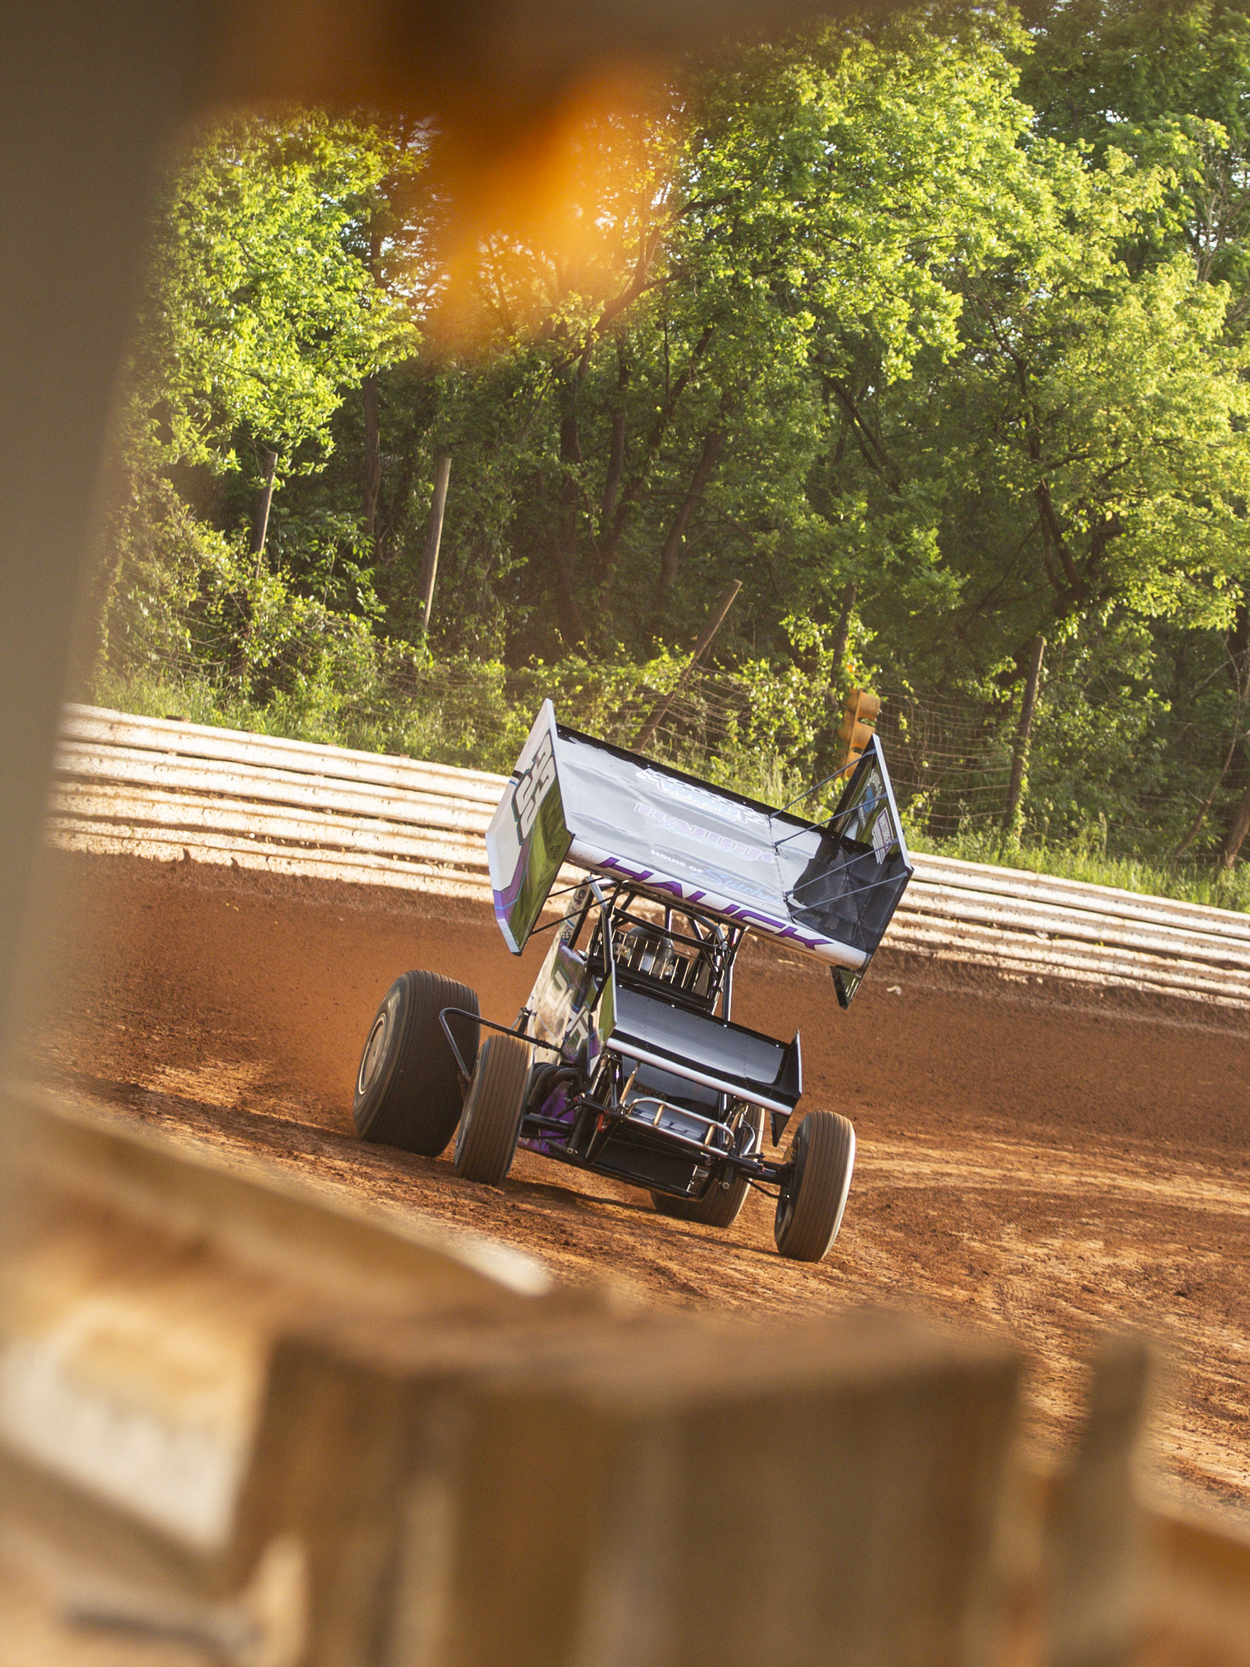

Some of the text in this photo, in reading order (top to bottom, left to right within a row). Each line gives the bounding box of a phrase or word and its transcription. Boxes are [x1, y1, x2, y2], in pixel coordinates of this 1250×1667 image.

[651, 850, 686, 867] HOUSE
[689, 864, 704, 874] OF
[596, 856, 833, 950] HAUCK
